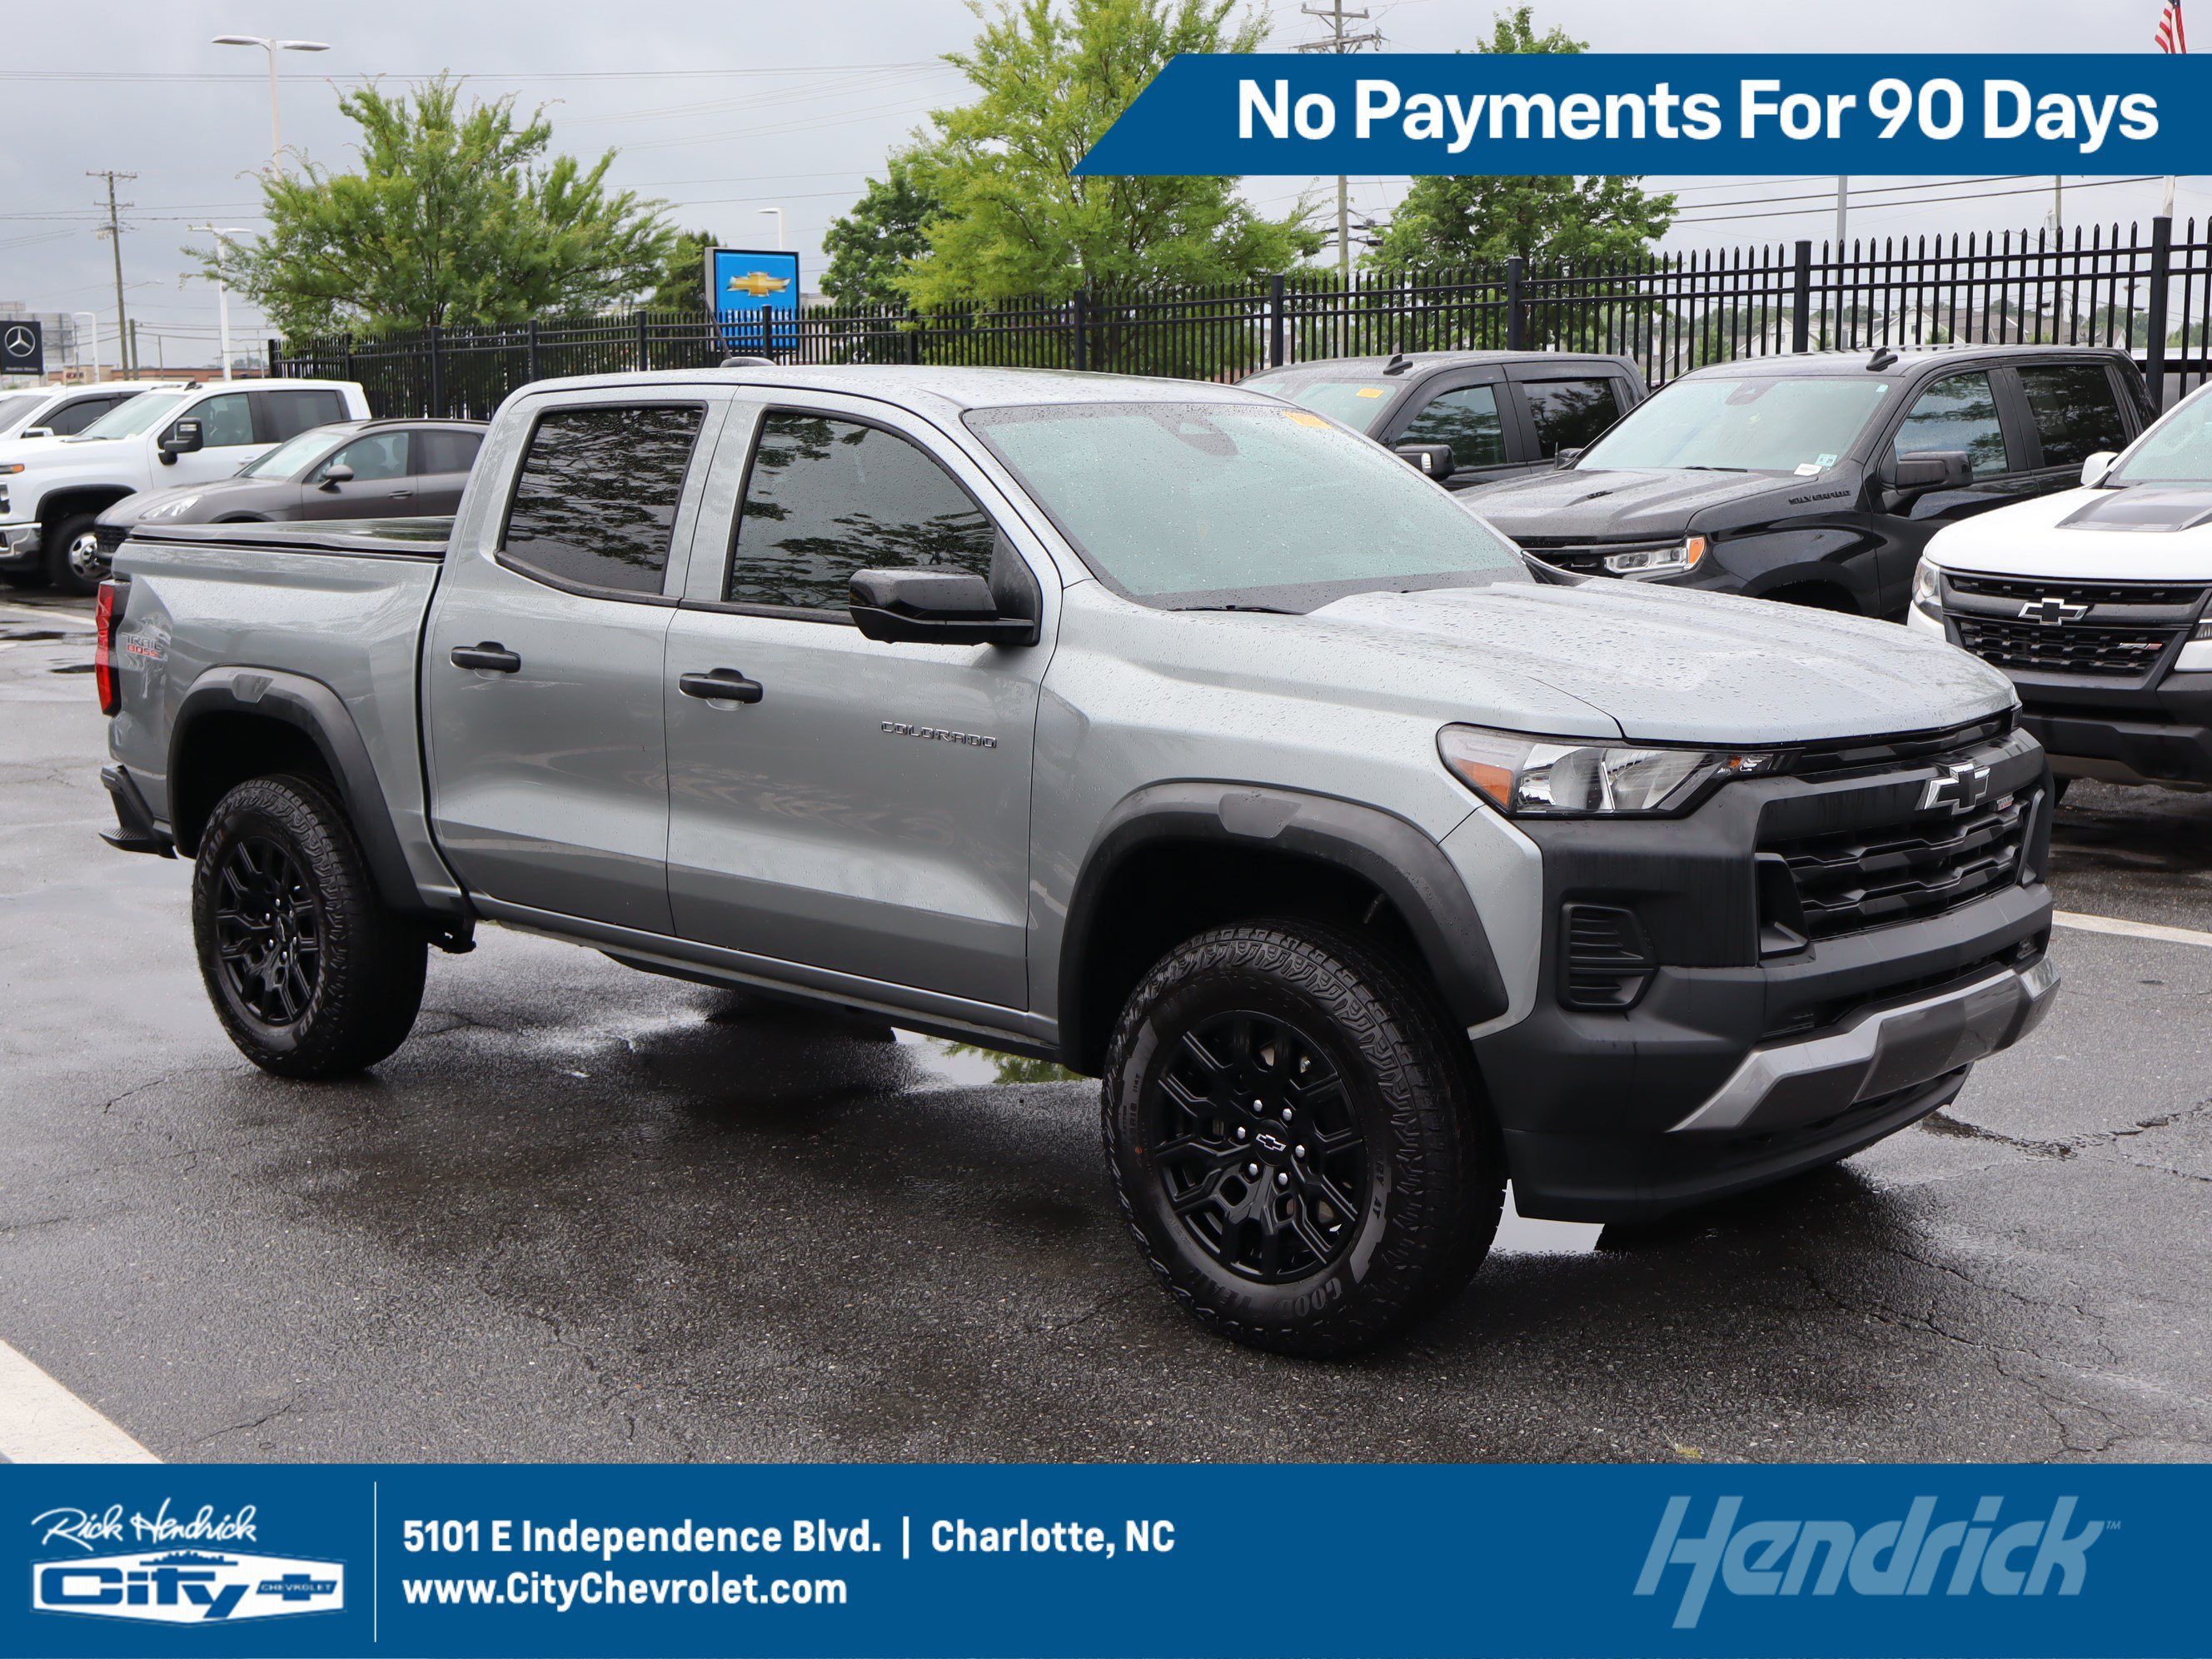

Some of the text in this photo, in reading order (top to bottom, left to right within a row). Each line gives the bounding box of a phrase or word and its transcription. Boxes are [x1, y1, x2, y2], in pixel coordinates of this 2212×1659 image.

[121, 632, 163, 652] TRAIL
[127, 644, 160, 660] BOSS
[881, 721, 998, 749] COLORADO
